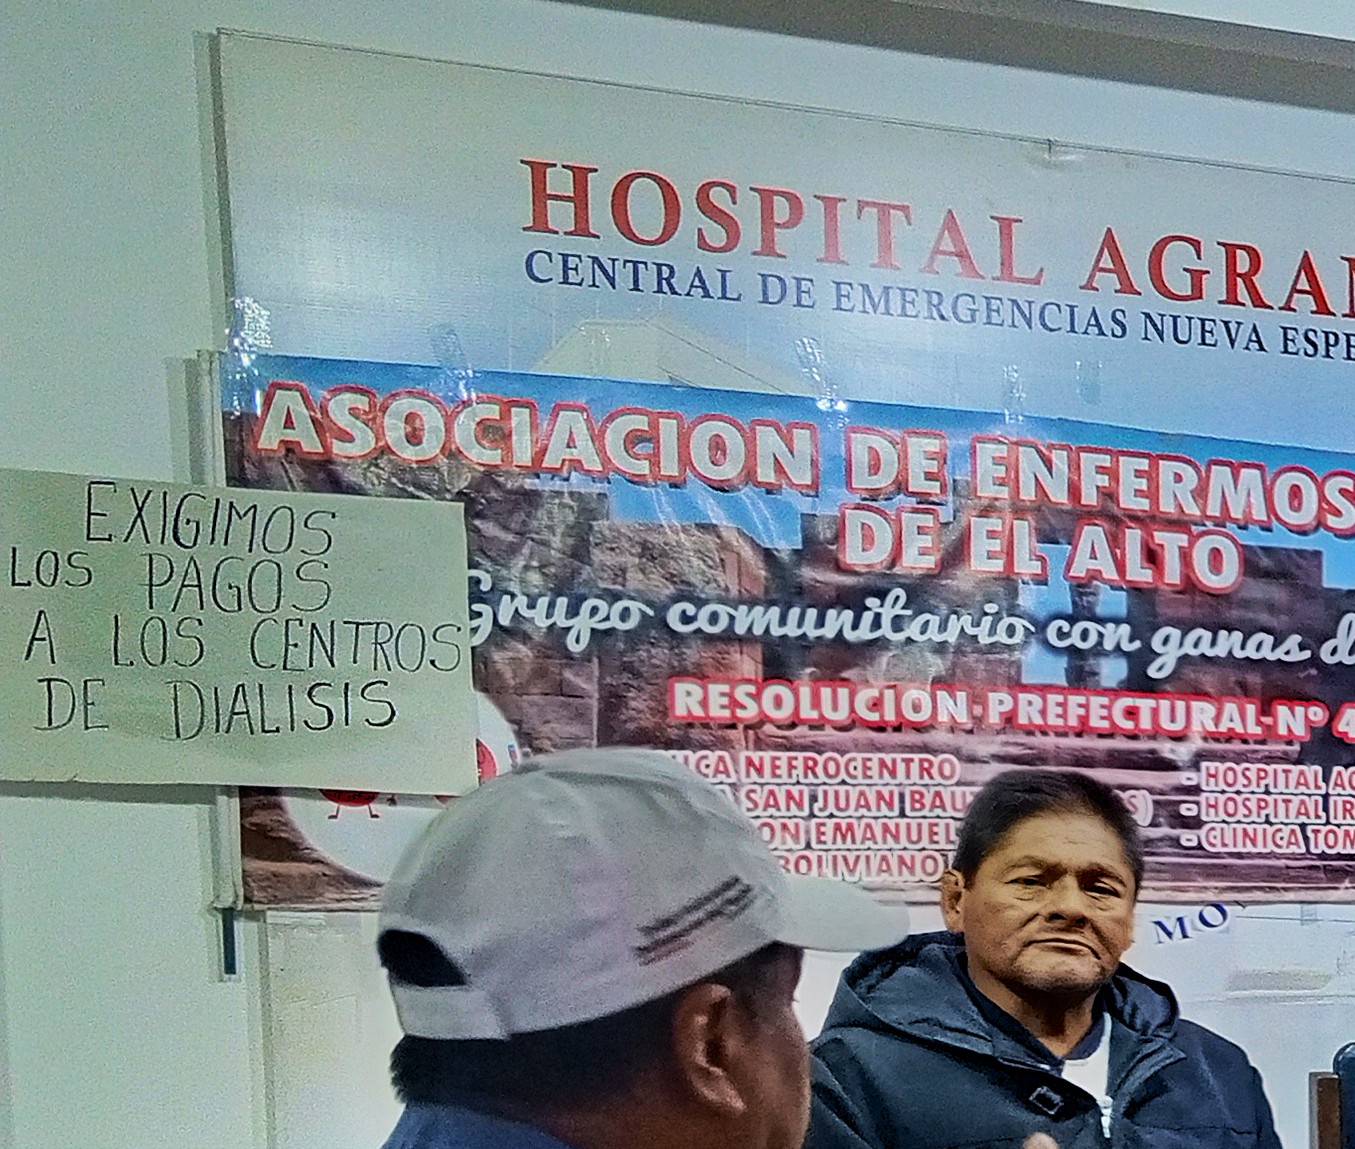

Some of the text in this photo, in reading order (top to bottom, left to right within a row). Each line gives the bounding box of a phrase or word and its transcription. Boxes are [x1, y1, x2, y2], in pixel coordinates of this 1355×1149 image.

[520, 158, 1044, 286] HOSPITAL
[525, 250, 742, 302] CENTRAL
[758, 272, 816, 309] DE
[832, 280, 1128, 339] EMERGENCIAS
[1141, 311, 1268, 354] NUEVA
[254, 383, 818, 492] ASOCIACION
[847, 426, 946, 496] DE
[85, 480, 336, 556] EXIGIMOS
[841, 504, 1242, 594] DE EL ALTO
[10, 545, 332, 614] LOS PAGOS
[24, 608, 468, 673] A LOS CENTROS
[666, 588, 1035, 645] comunitario
[1046, 619, 1141, 651] con
[1147, 626, 1311, 679] ganas
[33, 676, 398, 741] DE DIALISIS
[745, 754, 957, 781] NEFROCENTRO
[1205, 766, 1324, 791] HOSPITAL
[746, 788, 975, 815] SAN JUAN BAU
[757, 820, 956, 847] ON EMANUEL
[1205, 796, 1325, 820] HOSPITAL
[1204, 827, 1302, 849] CLINICA
